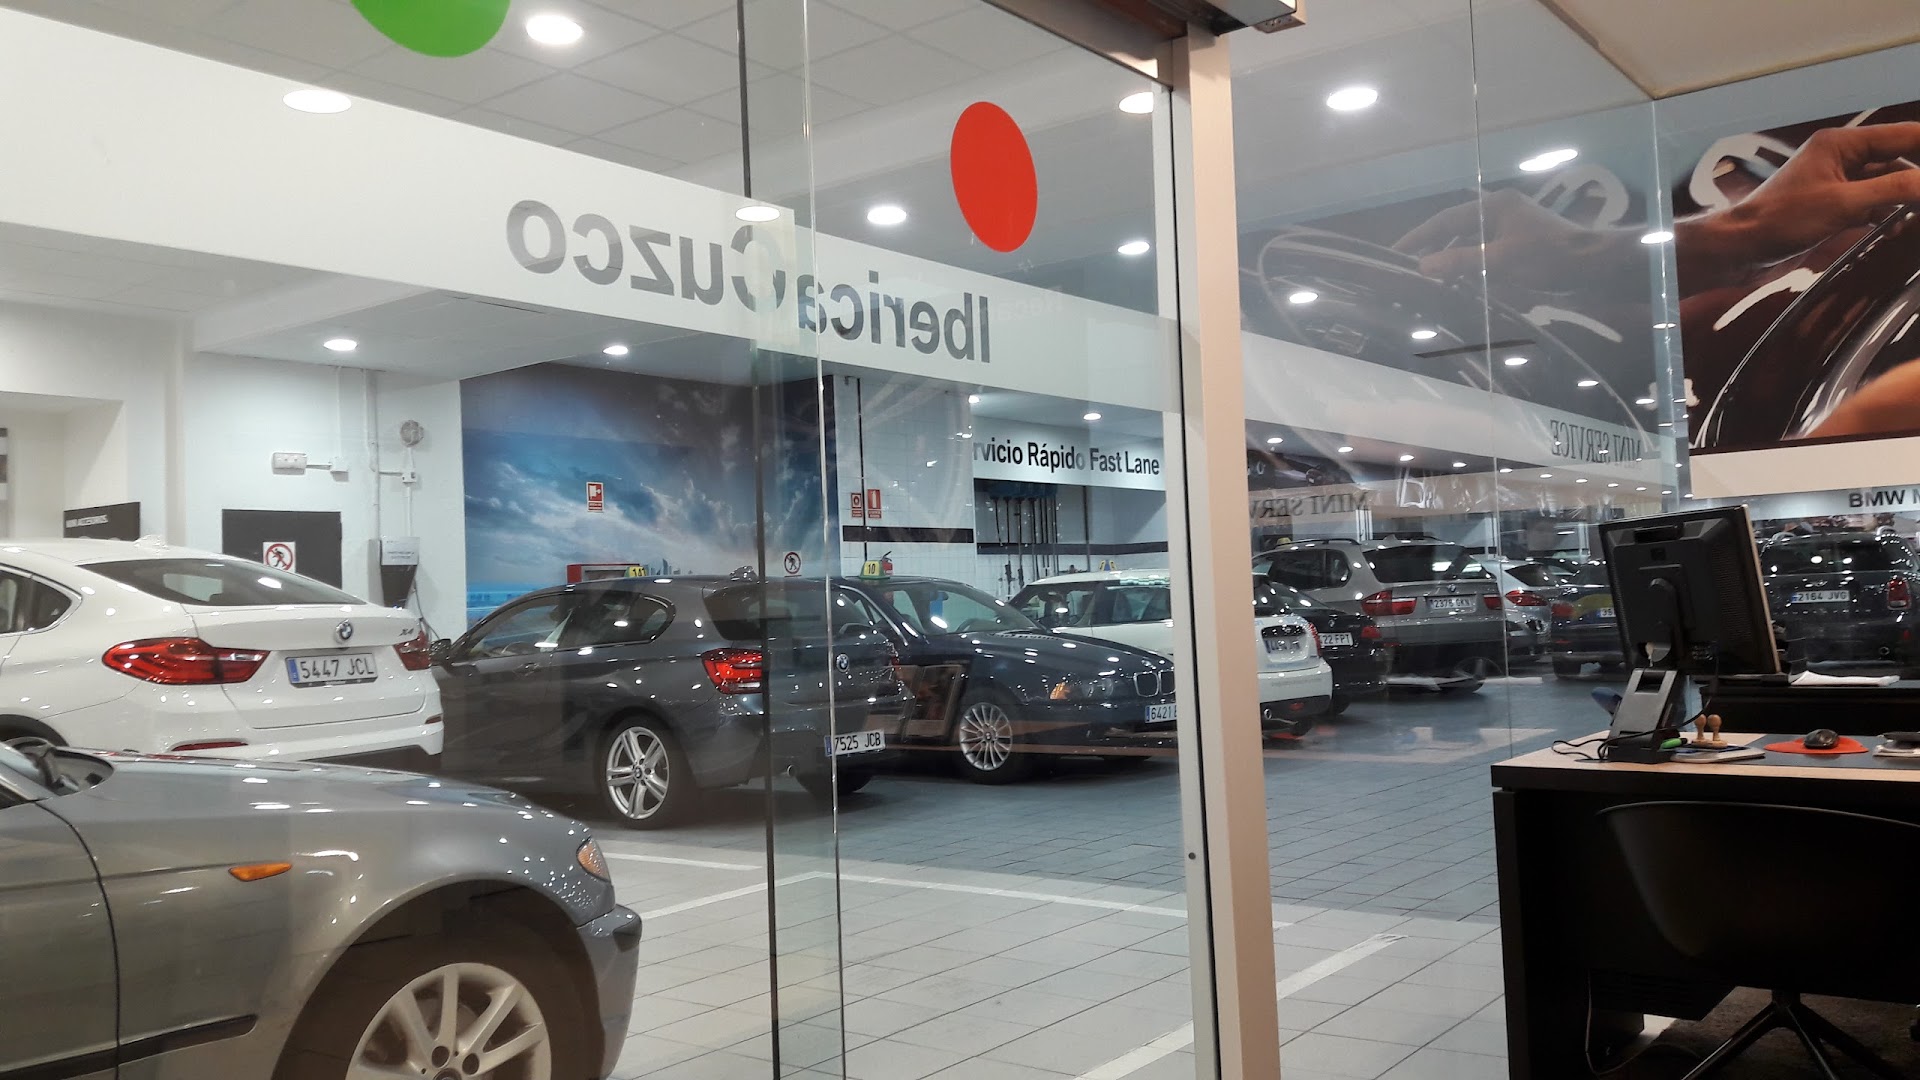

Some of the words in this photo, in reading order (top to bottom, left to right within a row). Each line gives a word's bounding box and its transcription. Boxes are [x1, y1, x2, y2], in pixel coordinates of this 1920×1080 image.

[1027, 441, 1086, 474] Rápido
[1089, 447, 1123, 474] Fast
[1124, 450, 1160, 476] Lane
[1848, 489, 1906, 508] BMW
[867, 563, 876, 575] 10
[1335, 634, 1350, 645] FPT
[300, 659, 340, 679] 5447
[346, 655, 375, 676] JCL
[1151, 706, 1172, 720] 6421
[834, 734, 859, 751] 7525
[864, 731, 881, 748] JCB
